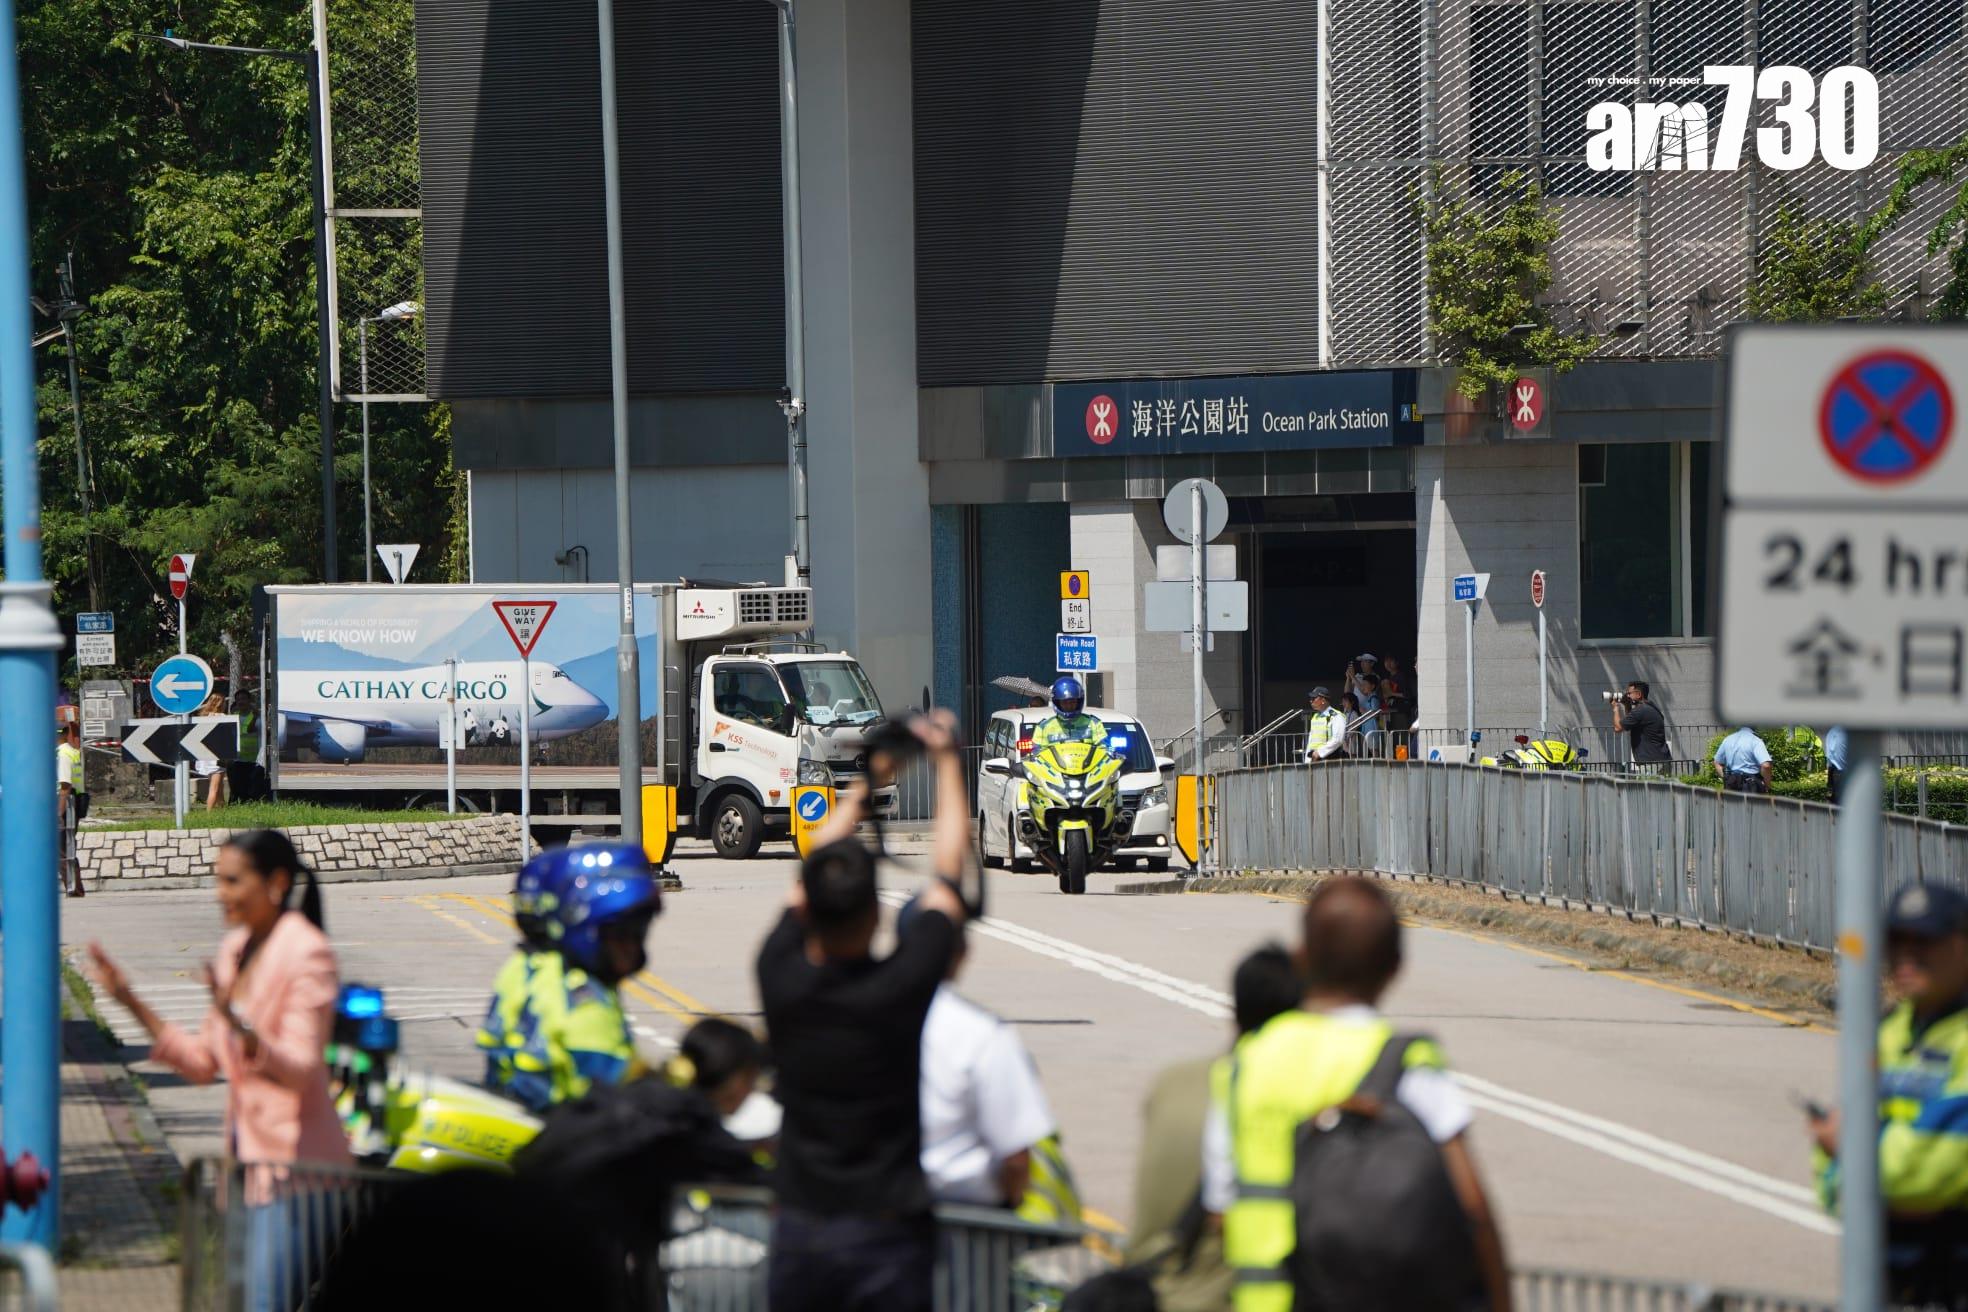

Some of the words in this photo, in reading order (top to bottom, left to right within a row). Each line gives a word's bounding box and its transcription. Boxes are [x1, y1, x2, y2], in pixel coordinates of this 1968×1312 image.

[1131, 396, 1250, 438] 海洋公園站
[1262, 411, 1304, 433] Ocean
[1308, 410, 1337, 431] Park
[1340, 407, 1389, 430] Station
[1762, 531, 1860, 592] 24
[1885, 531, 1968, 593] hr
[513, 608, 536, 616] GIVE
[1069, 603, 1082, 613] End
[514, 617, 536, 625] WAY
[301, 629, 325, 643] WE
[328, 629, 375, 643] KNOW
[380, 629, 416, 643] HOW
[1060, 638, 1078, 648] Private
[1080, 638, 1095, 648] Road
[1063, 651, 1091, 667] 私家路
[1782, 614, 1964, 701] 全日
[317, 680, 415, 699] CATHAY
